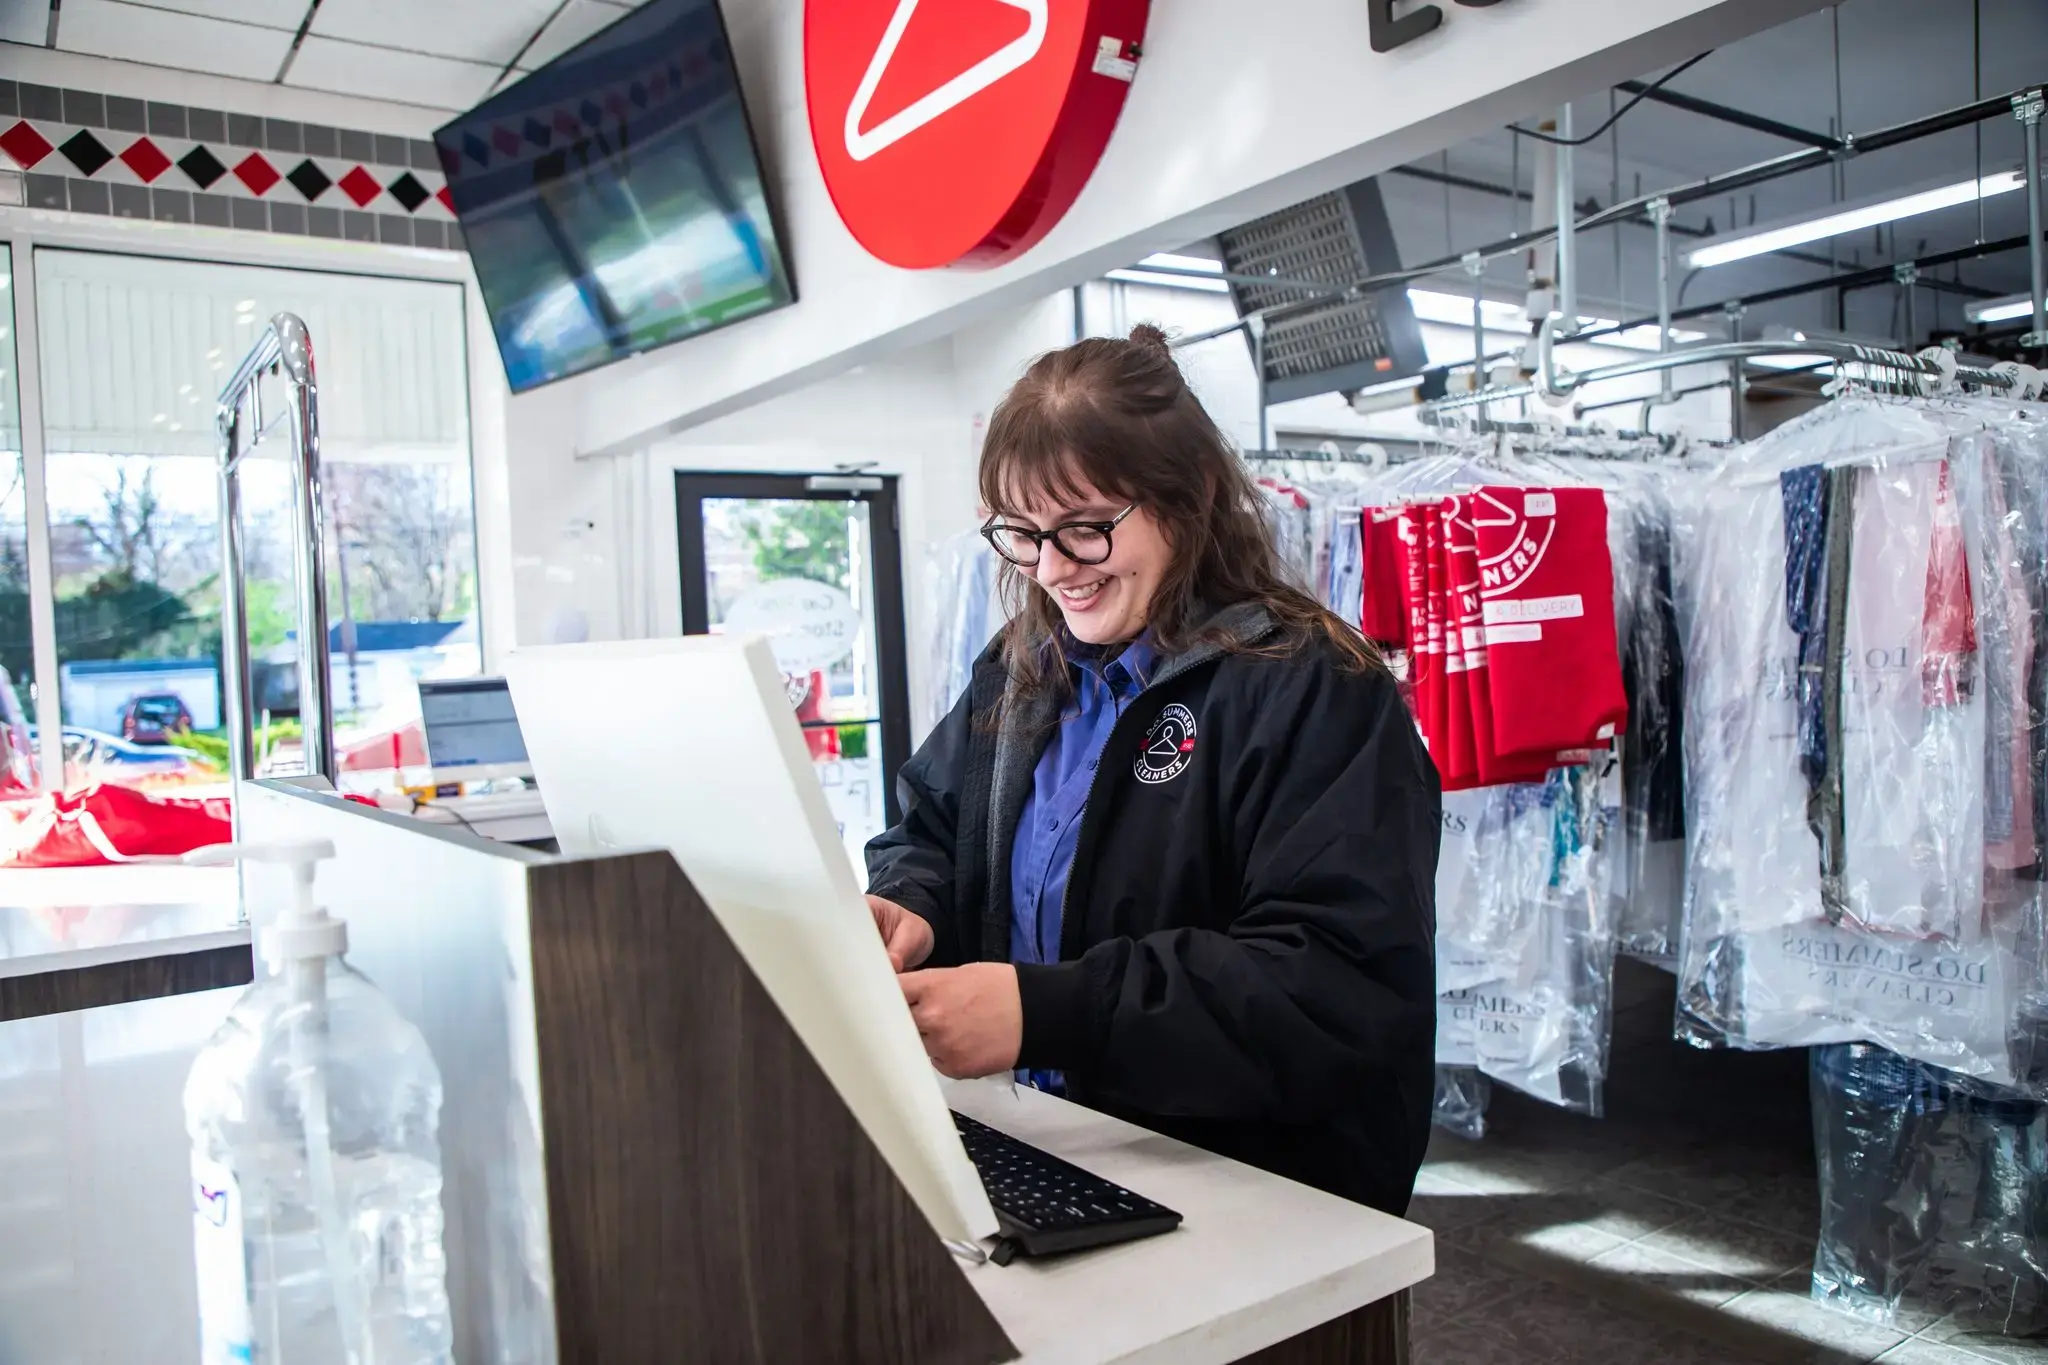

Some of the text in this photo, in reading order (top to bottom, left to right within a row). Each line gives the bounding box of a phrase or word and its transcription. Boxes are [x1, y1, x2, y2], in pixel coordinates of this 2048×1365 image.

[1482, 537, 1537, 587] NERS
[1510, 599, 1577, 616] DELIVERY
[1163, 707, 1194, 736] SUMMERS
[1136, 759, 1183, 780] CLEANERS
